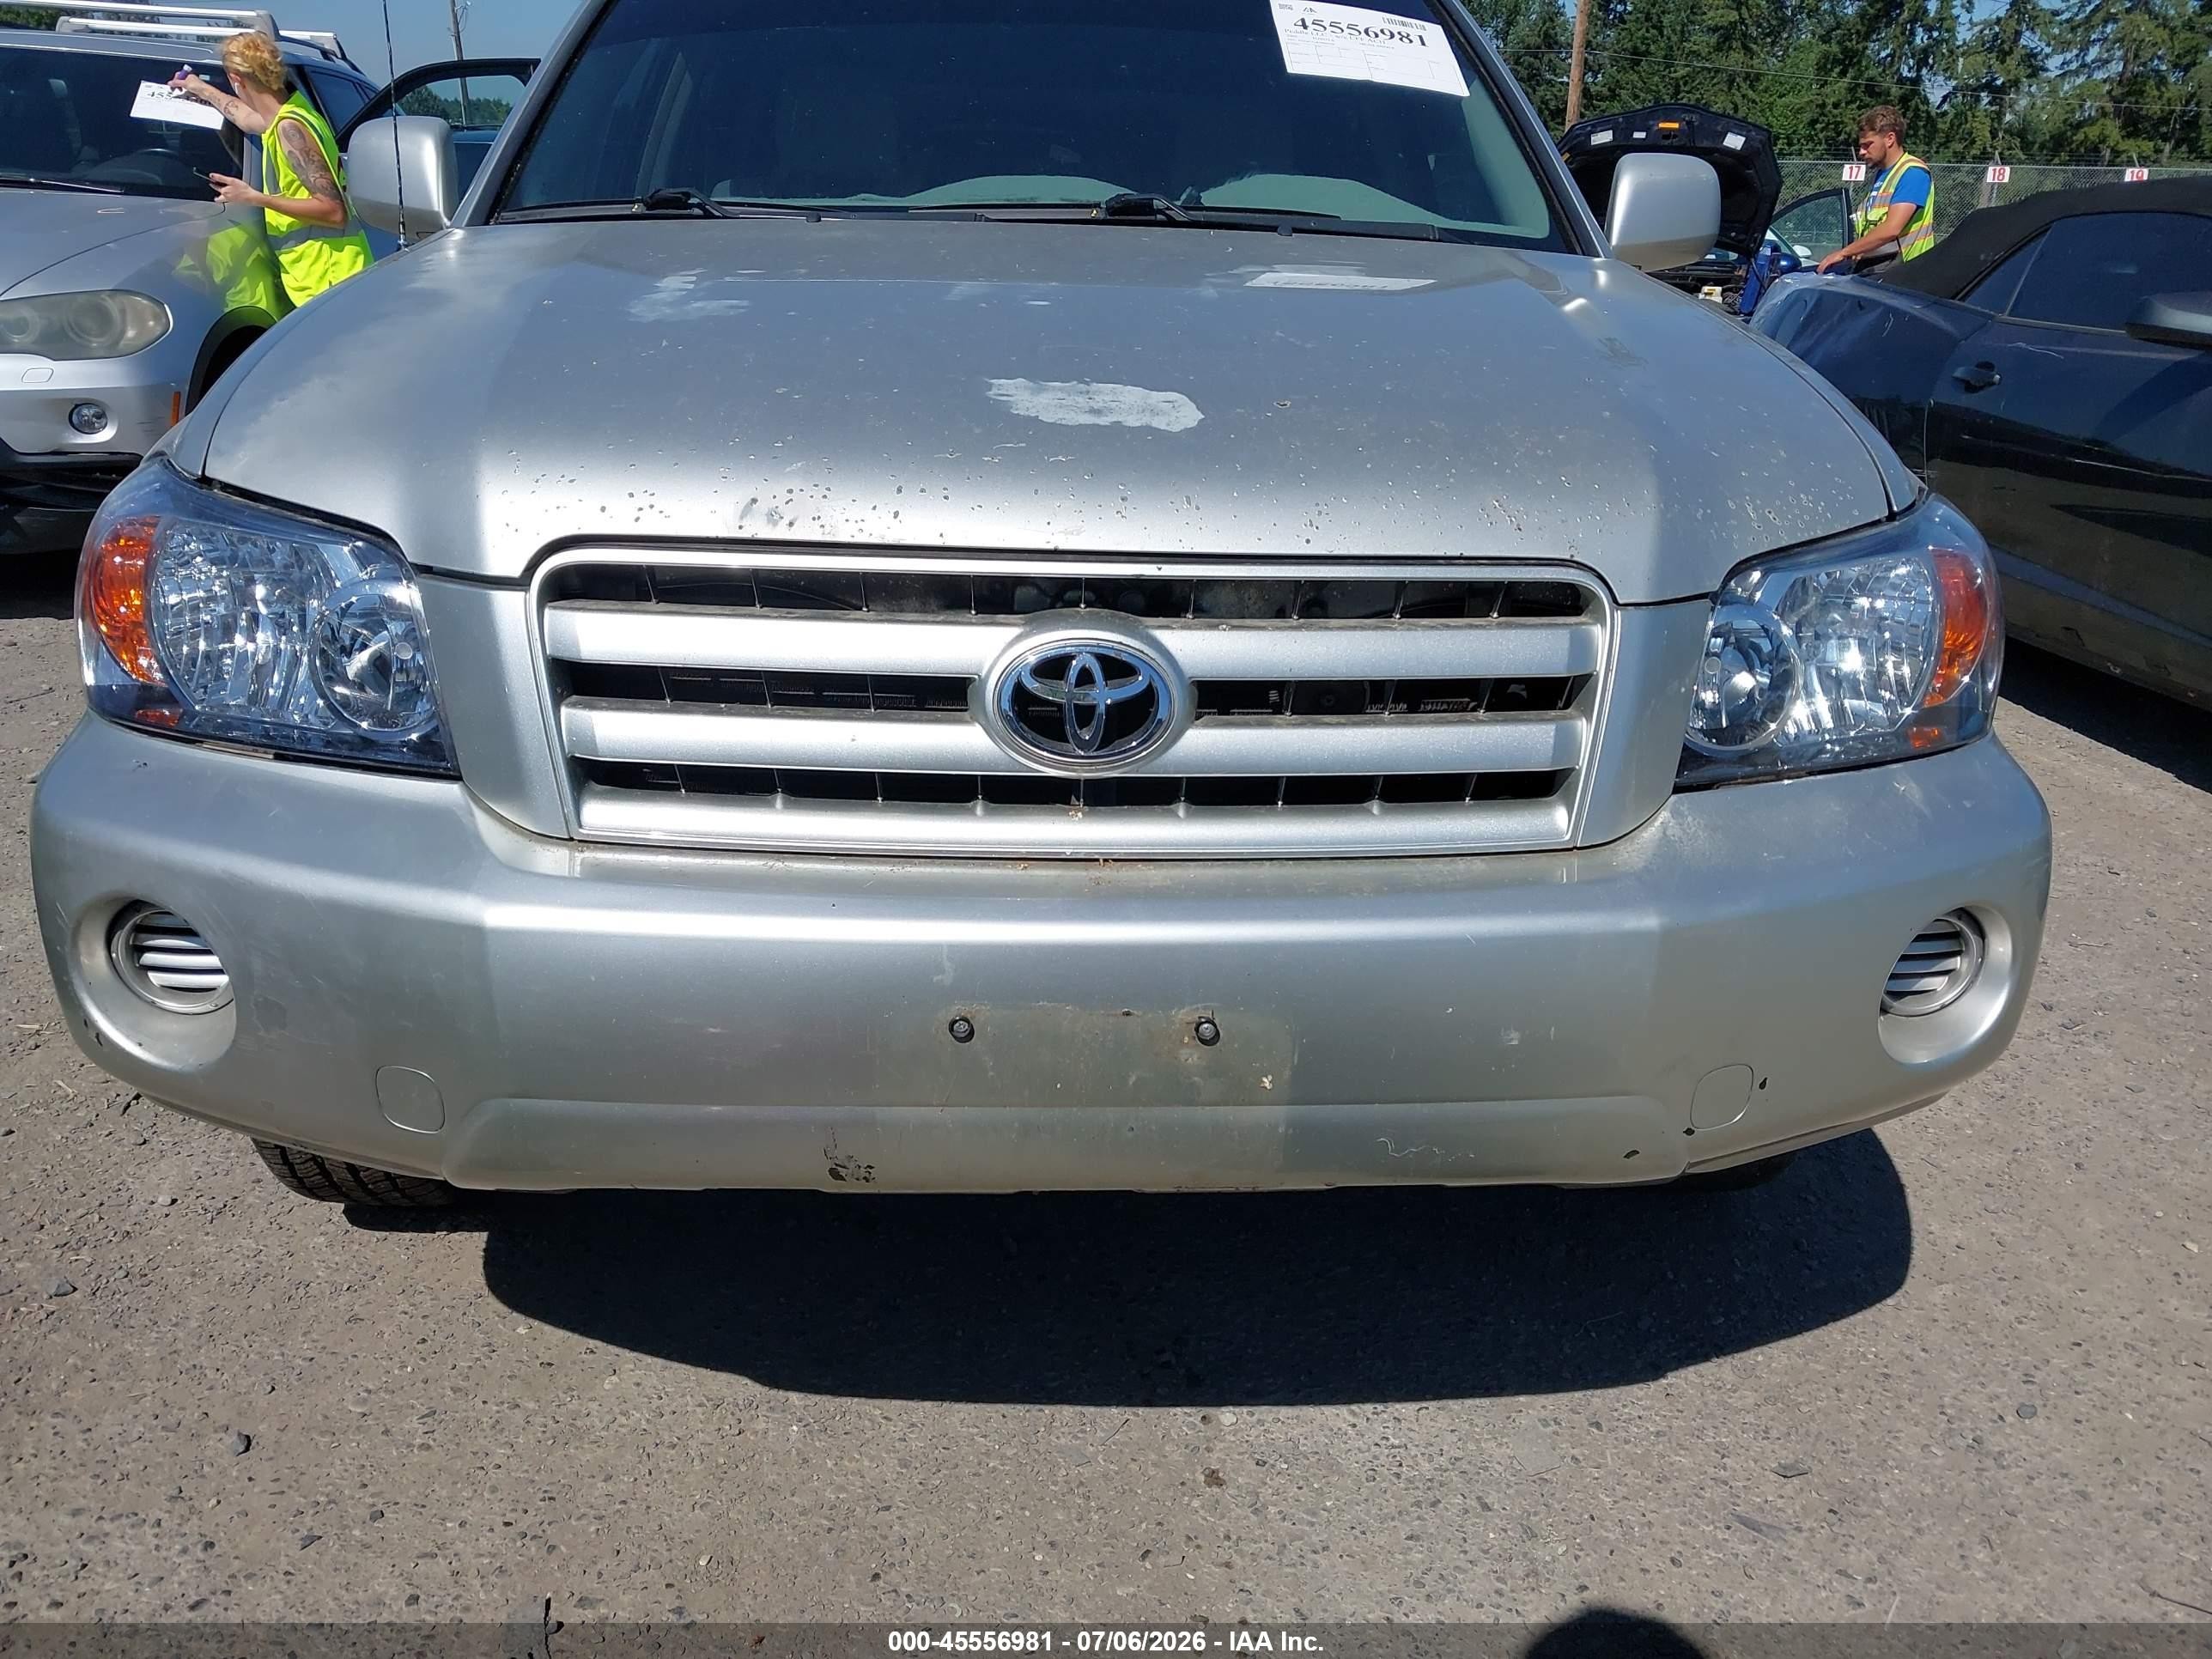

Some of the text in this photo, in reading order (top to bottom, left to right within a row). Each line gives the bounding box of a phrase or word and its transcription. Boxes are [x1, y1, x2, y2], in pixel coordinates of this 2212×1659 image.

[1293, 17, 1430, 47] 45556981
[1848, 165, 1862, 179] 17
[1991, 167, 2006, 181] 18
